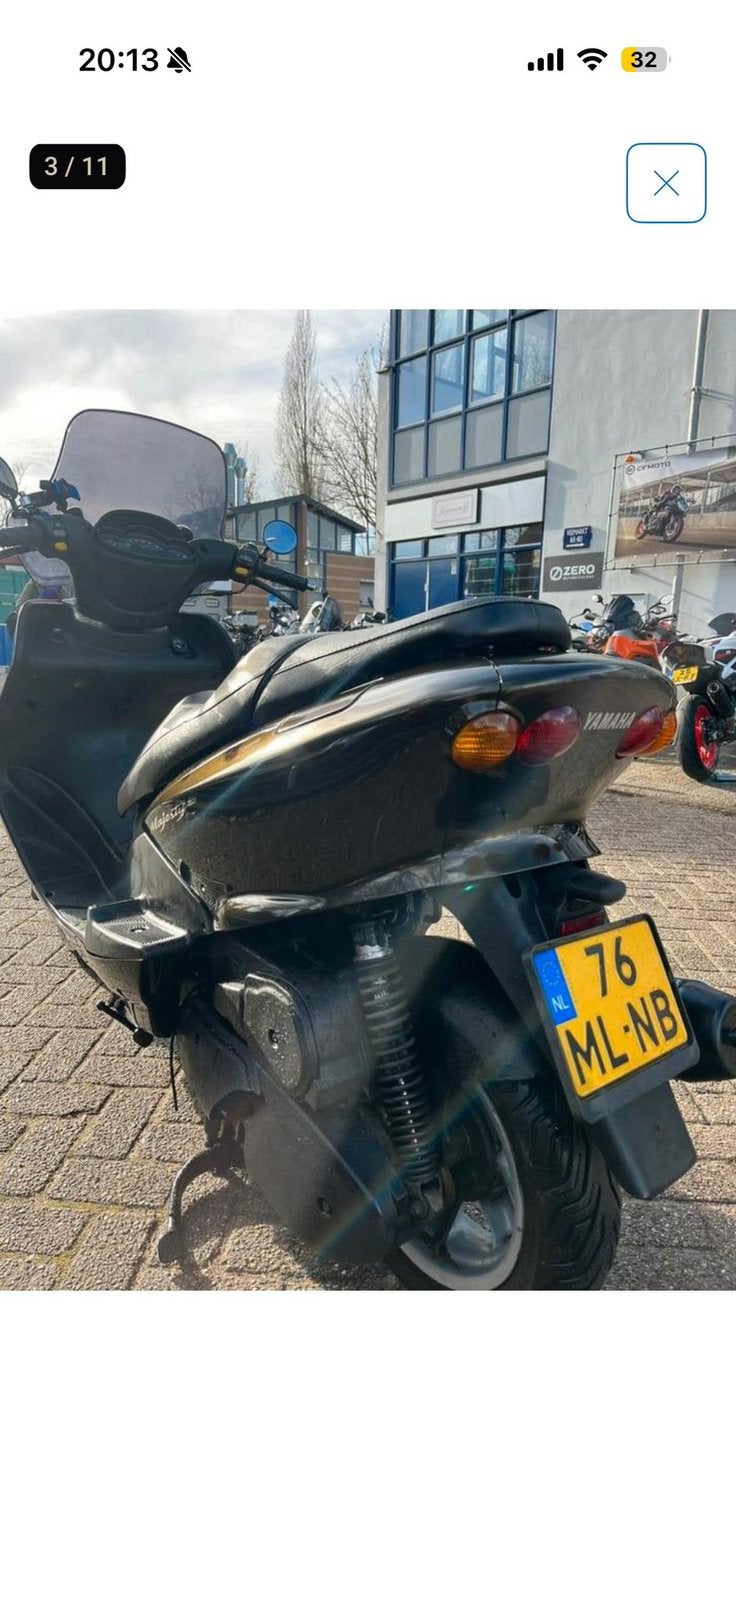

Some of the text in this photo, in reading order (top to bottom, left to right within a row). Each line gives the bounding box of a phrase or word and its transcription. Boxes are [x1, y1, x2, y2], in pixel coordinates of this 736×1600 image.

[563, 564, 596, 576] ZERO
[583, 711, 637, 730] YAMAHA
[151, 801, 186, 833] Majesty
[584, 936, 637, 998] 76
[551, 996, 569, 1013] NL
